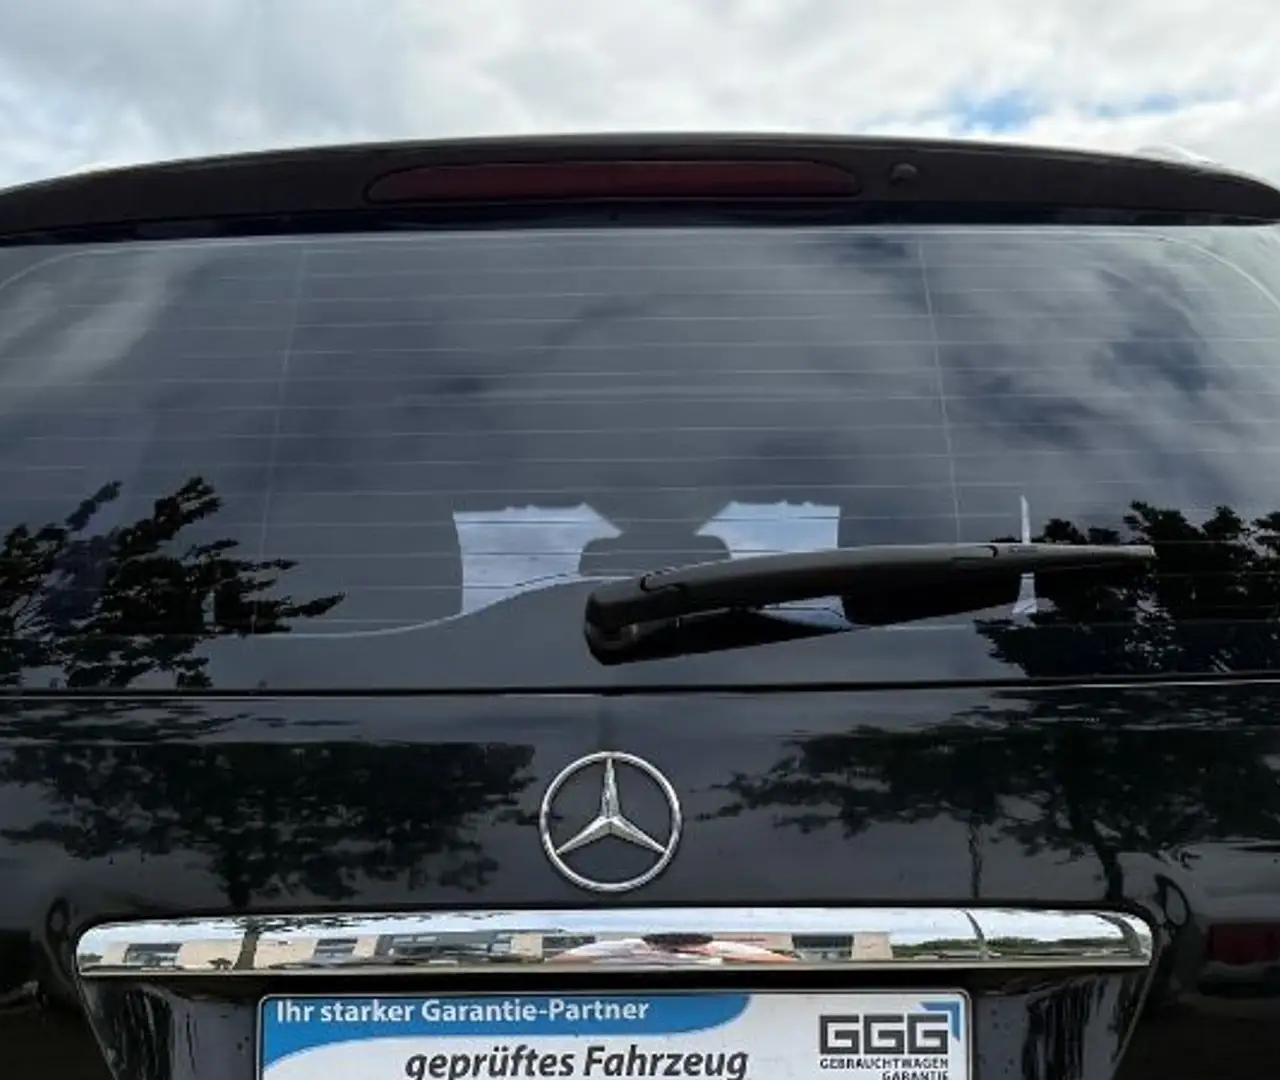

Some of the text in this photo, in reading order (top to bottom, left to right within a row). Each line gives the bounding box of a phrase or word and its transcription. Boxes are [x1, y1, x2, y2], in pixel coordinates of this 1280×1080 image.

[277, 998, 650, 1023] Ihr starker Garantie-Partner
[820, 1015, 949, 1055] GGG
[820, 1058, 949, 1069] GEBRAUCHTWAGEN
